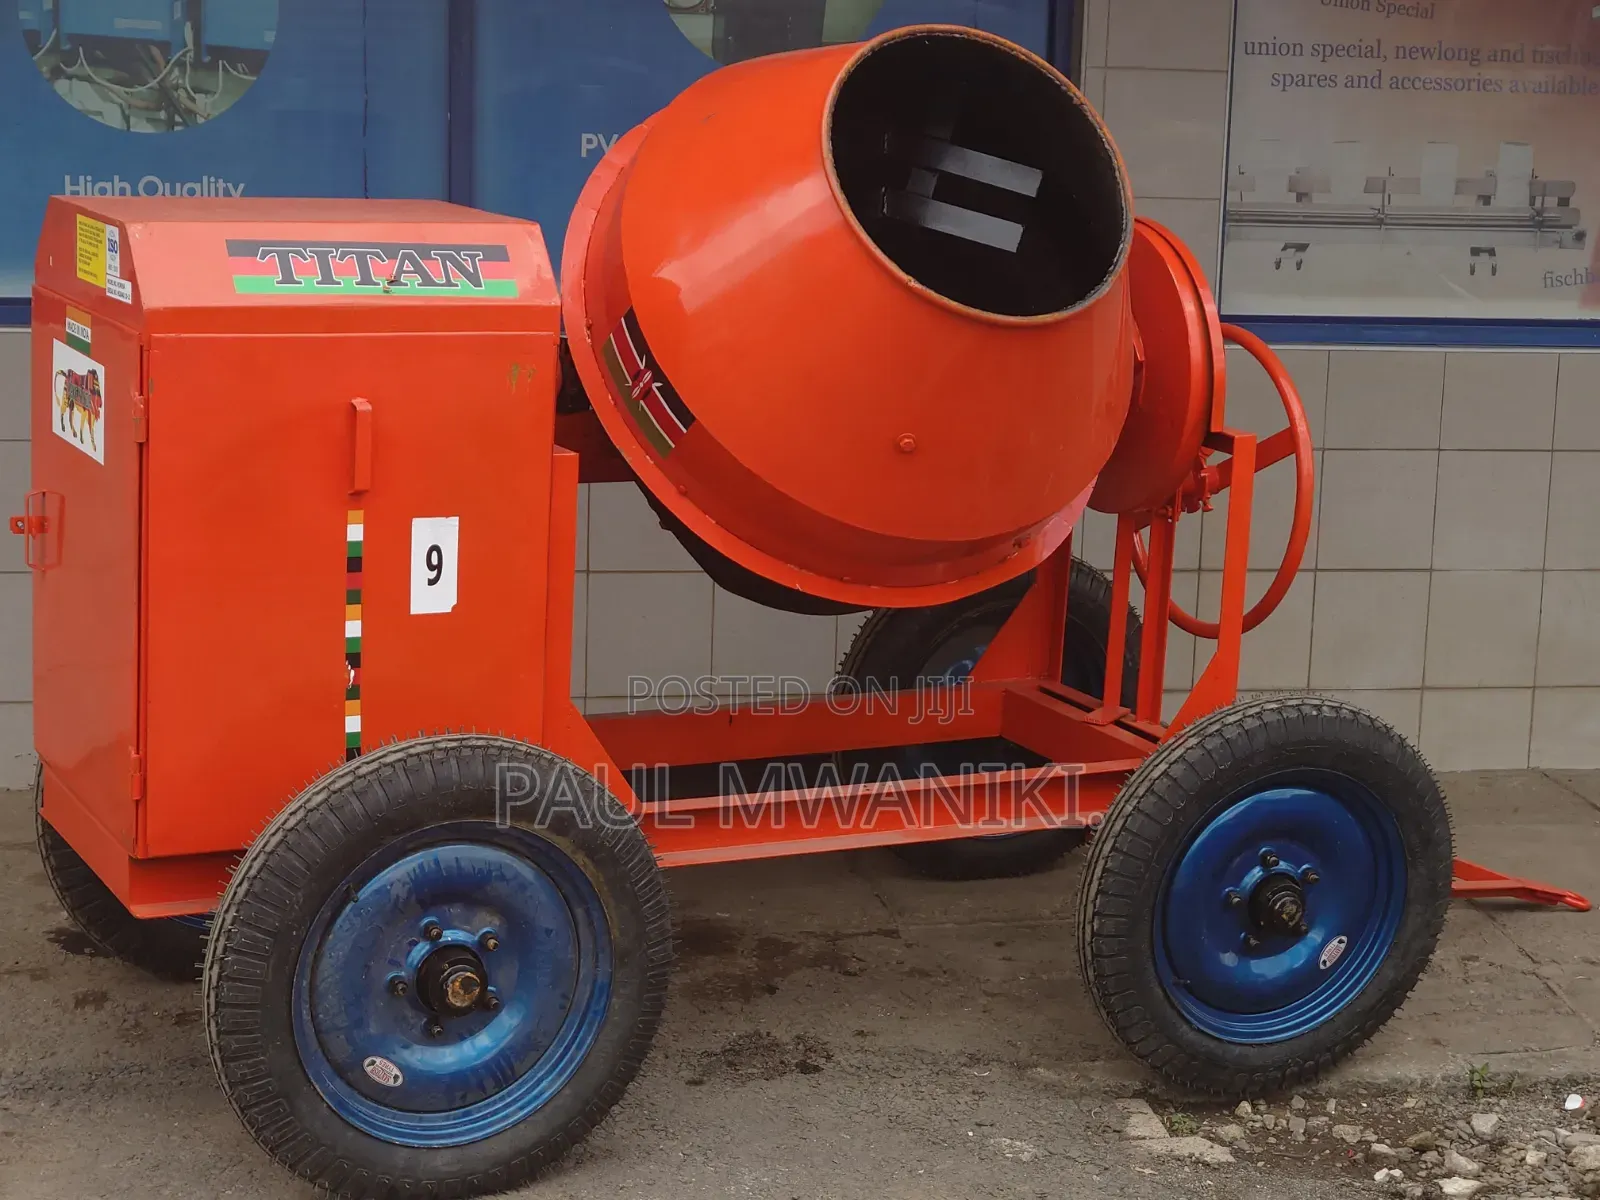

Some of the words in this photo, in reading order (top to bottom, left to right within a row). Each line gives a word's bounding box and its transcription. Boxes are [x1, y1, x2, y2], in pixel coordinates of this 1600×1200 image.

[1376, 0, 1436, 19] Special
[1244, 36, 1304, 57] union
[1310, 38, 1388, 62] special,
[1394, 40, 1481, 67] newlong
[1487, 43, 1525, 64] and
[1270, 71, 1338, 92] spares
[1344, 69, 1383, 90] and
[1389, 72, 1503, 93] accessories
[64, 175, 132, 197] High
[137, 175, 246, 198] Quality
[257, 247, 485, 290] TITAN
[425, 543, 443, 586] 9
